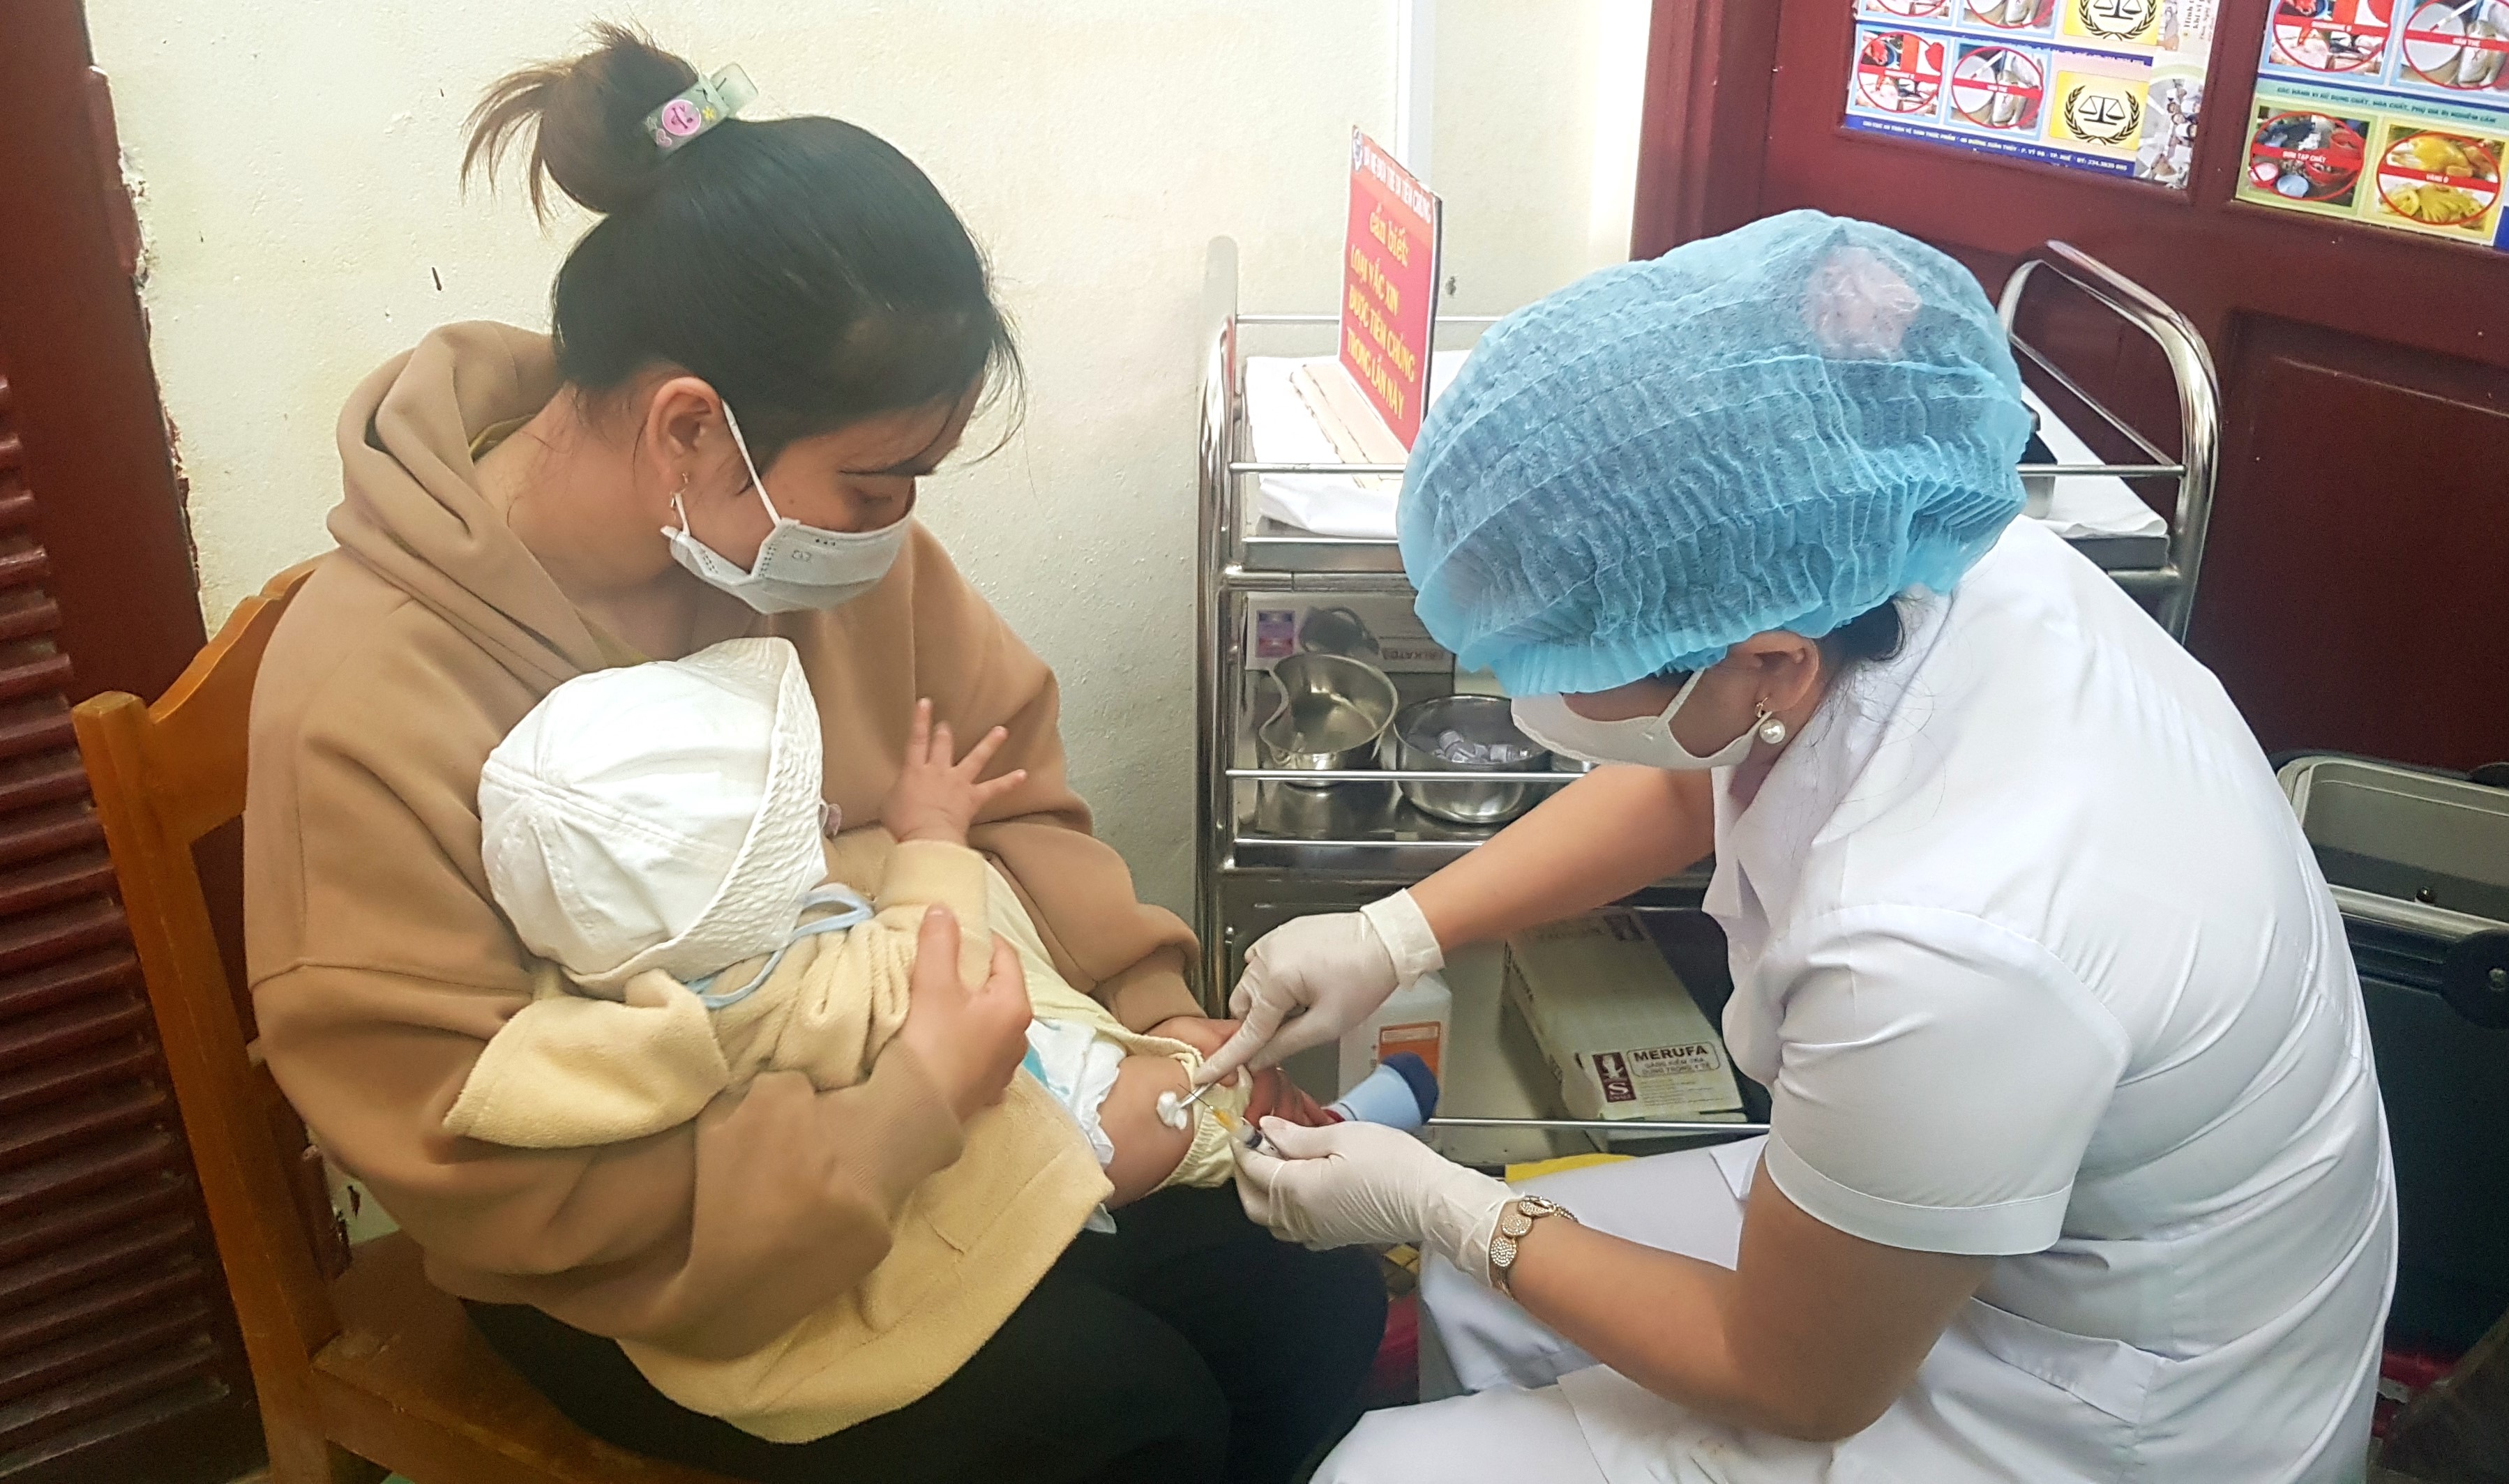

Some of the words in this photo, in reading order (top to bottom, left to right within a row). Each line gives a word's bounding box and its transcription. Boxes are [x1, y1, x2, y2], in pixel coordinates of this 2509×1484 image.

[1350, 244, 1368, 284] LOẠI
[1369, 257, 1385, 301] VẮC
[1385, 281, 1399, 317] XIN
[1348, 284, 1369, 328] ĐƯỢC
[1370, 308, 1387, 351] TIÊM
[1347, 326, 1371, 378] TRONG
[1634, 1045, 1708, 1061] MERUFA
